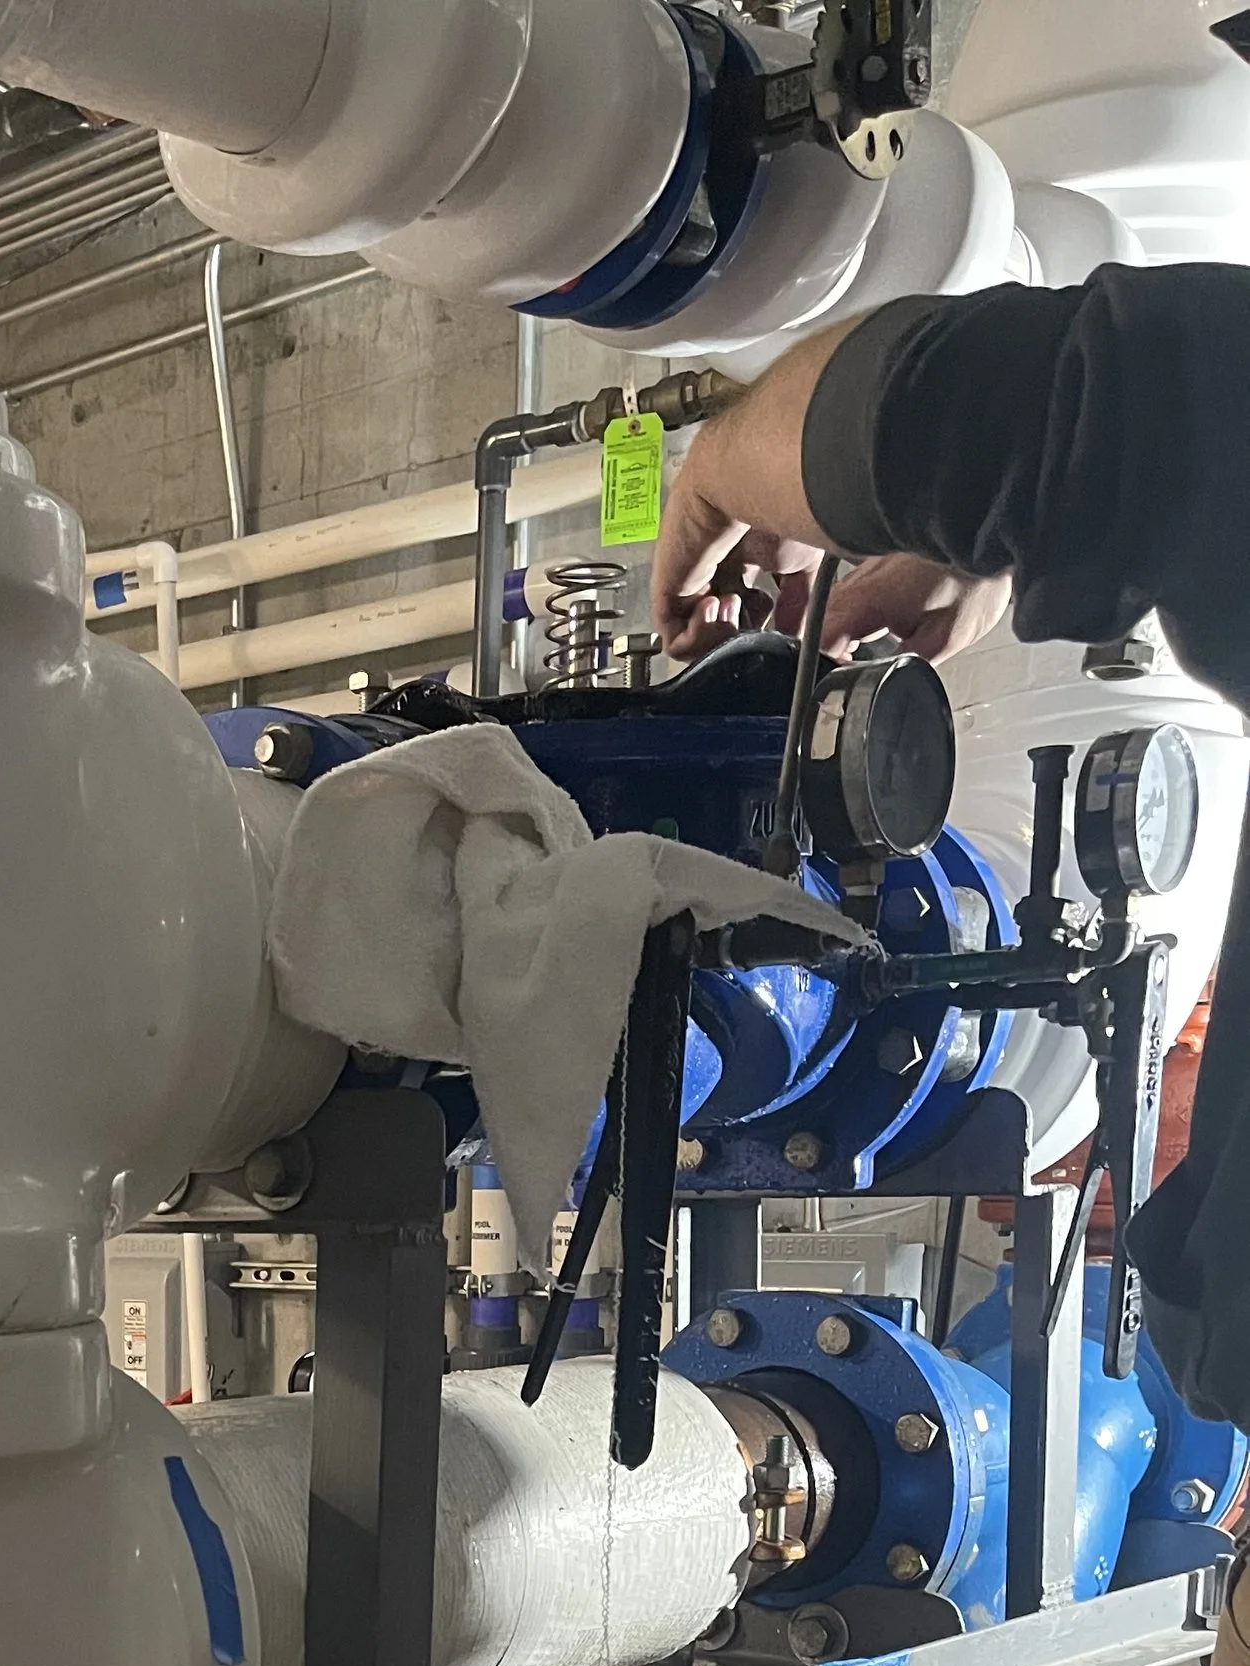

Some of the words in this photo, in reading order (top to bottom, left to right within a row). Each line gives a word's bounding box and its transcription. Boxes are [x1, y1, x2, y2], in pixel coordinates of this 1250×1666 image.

[763, 1238, 859, 1257] SIEMENS
[129, 1307, 141, 1316] ON
[127, 1355, 143, 1365] OFF
